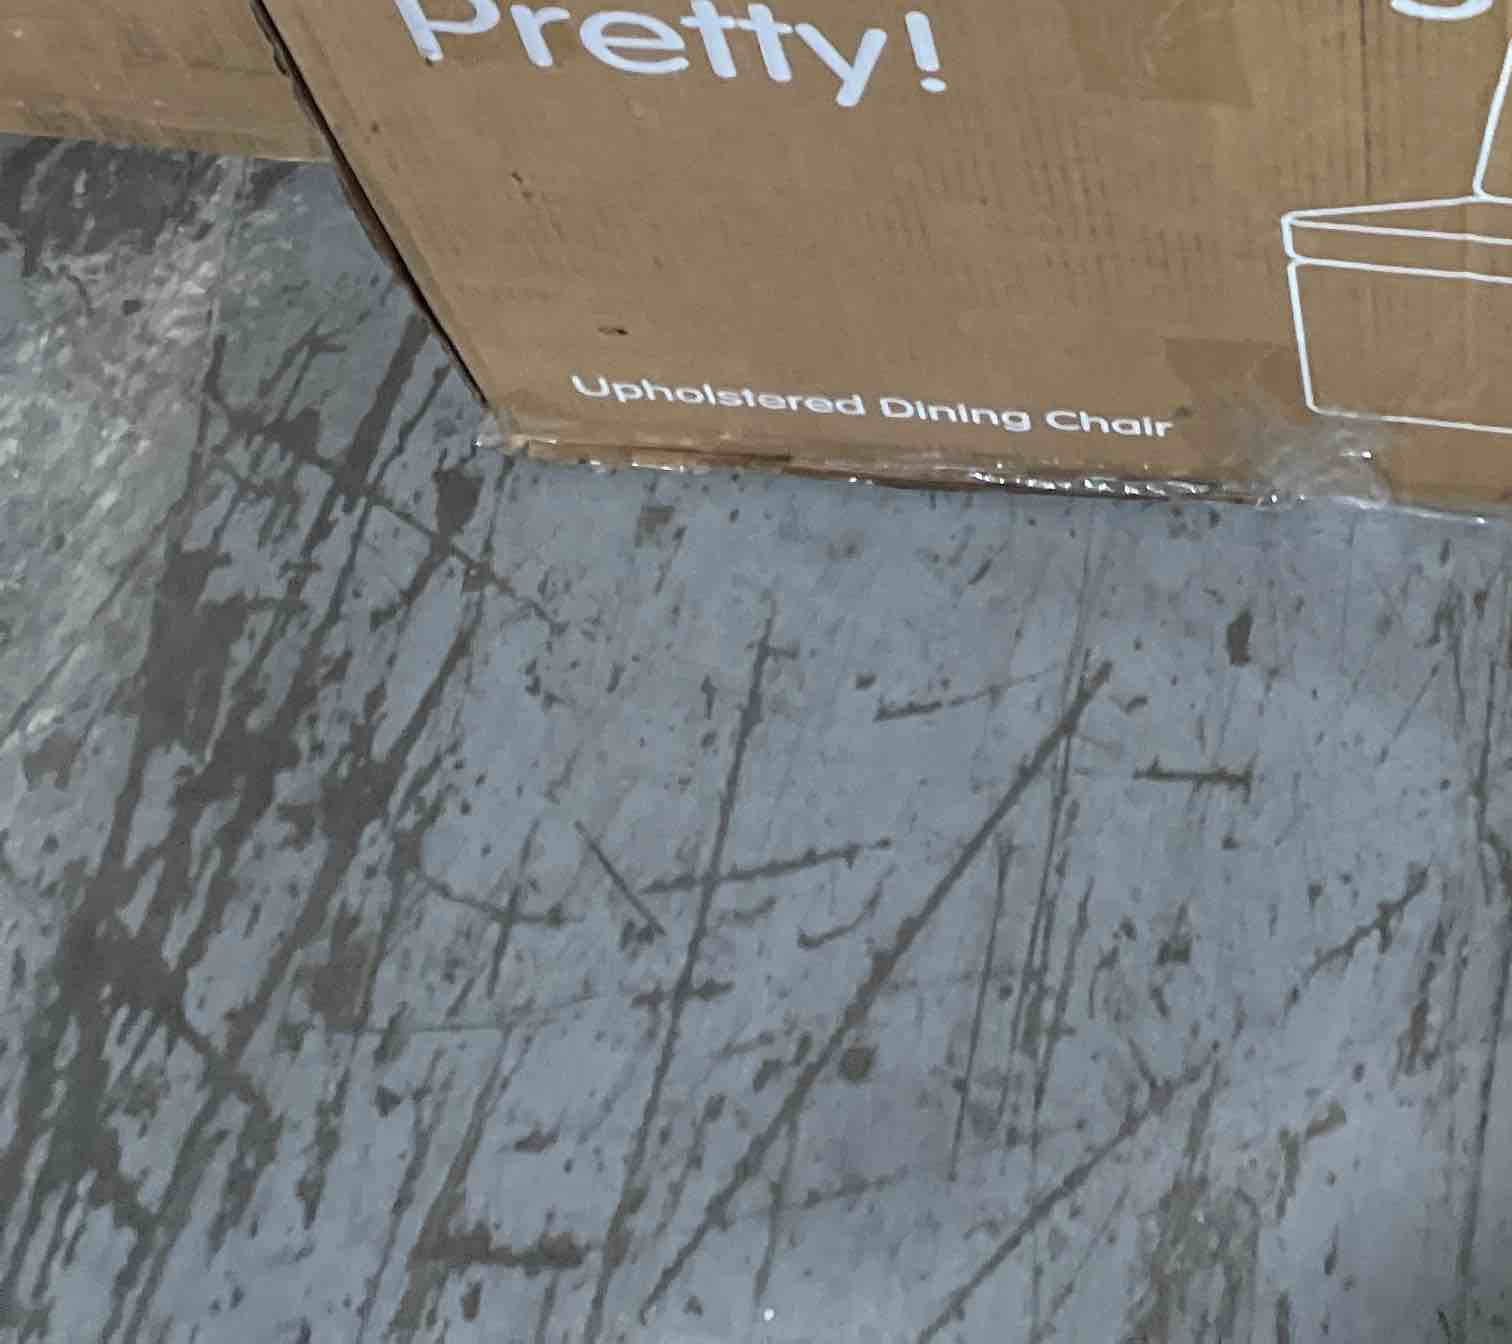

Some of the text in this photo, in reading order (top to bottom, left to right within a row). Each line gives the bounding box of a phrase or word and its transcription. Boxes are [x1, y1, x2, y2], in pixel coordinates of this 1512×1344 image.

[571, 374, 1174, 440] Upholstered Dining Chair
